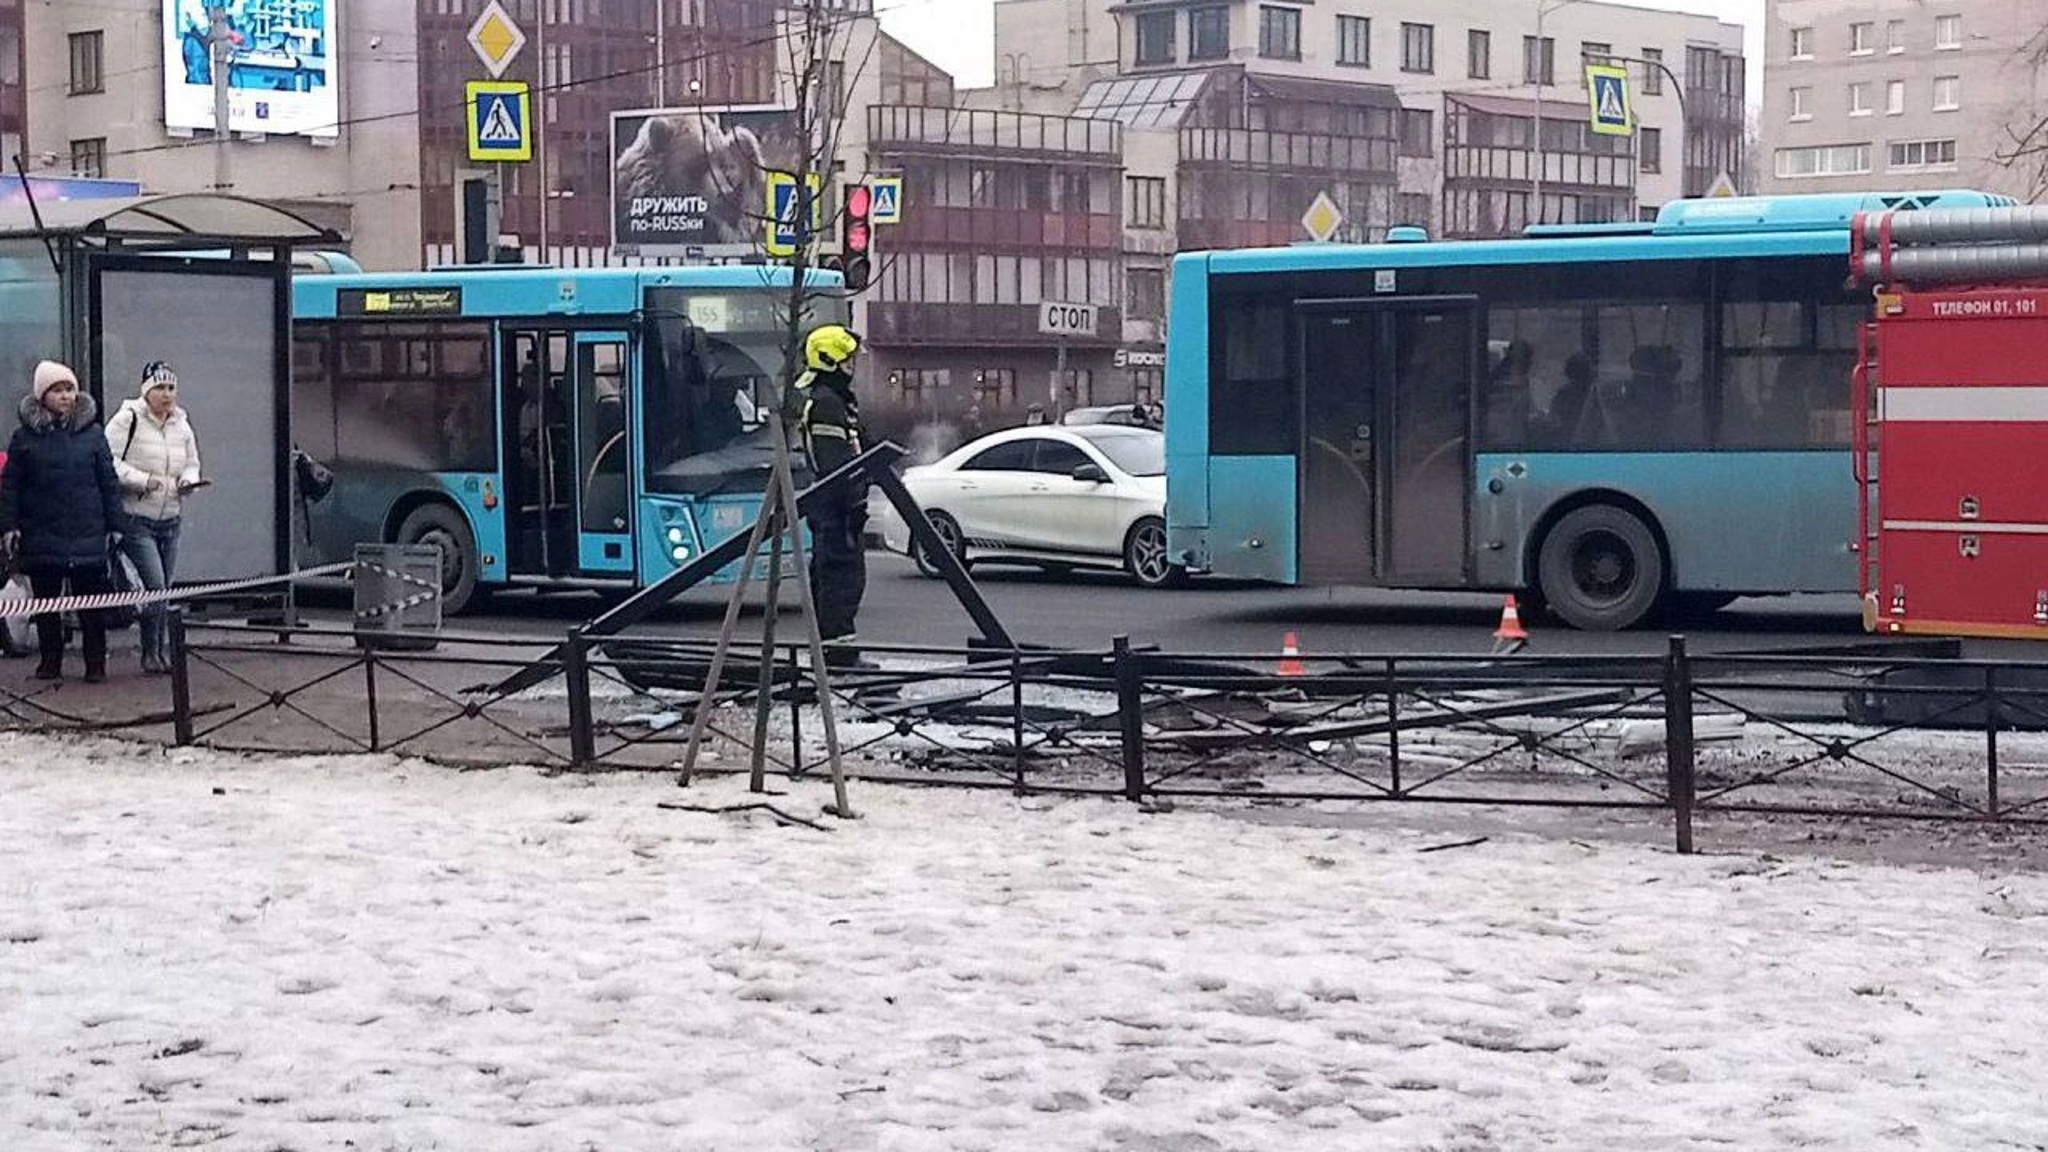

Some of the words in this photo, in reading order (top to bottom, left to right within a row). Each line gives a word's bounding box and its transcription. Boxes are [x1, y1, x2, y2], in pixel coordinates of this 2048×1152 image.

[630, 196, 708, 216] ДРУЖИТЬ
[631, 215, 704, 232] по-RUSSки
[1932, 300, 1991, 315] ТЕЛЕФОН
[1993, 299, 2012, 315] 01,
[2016, 299, 2036, 313] 101
[1049, 305, 1090, 330] СТОП
